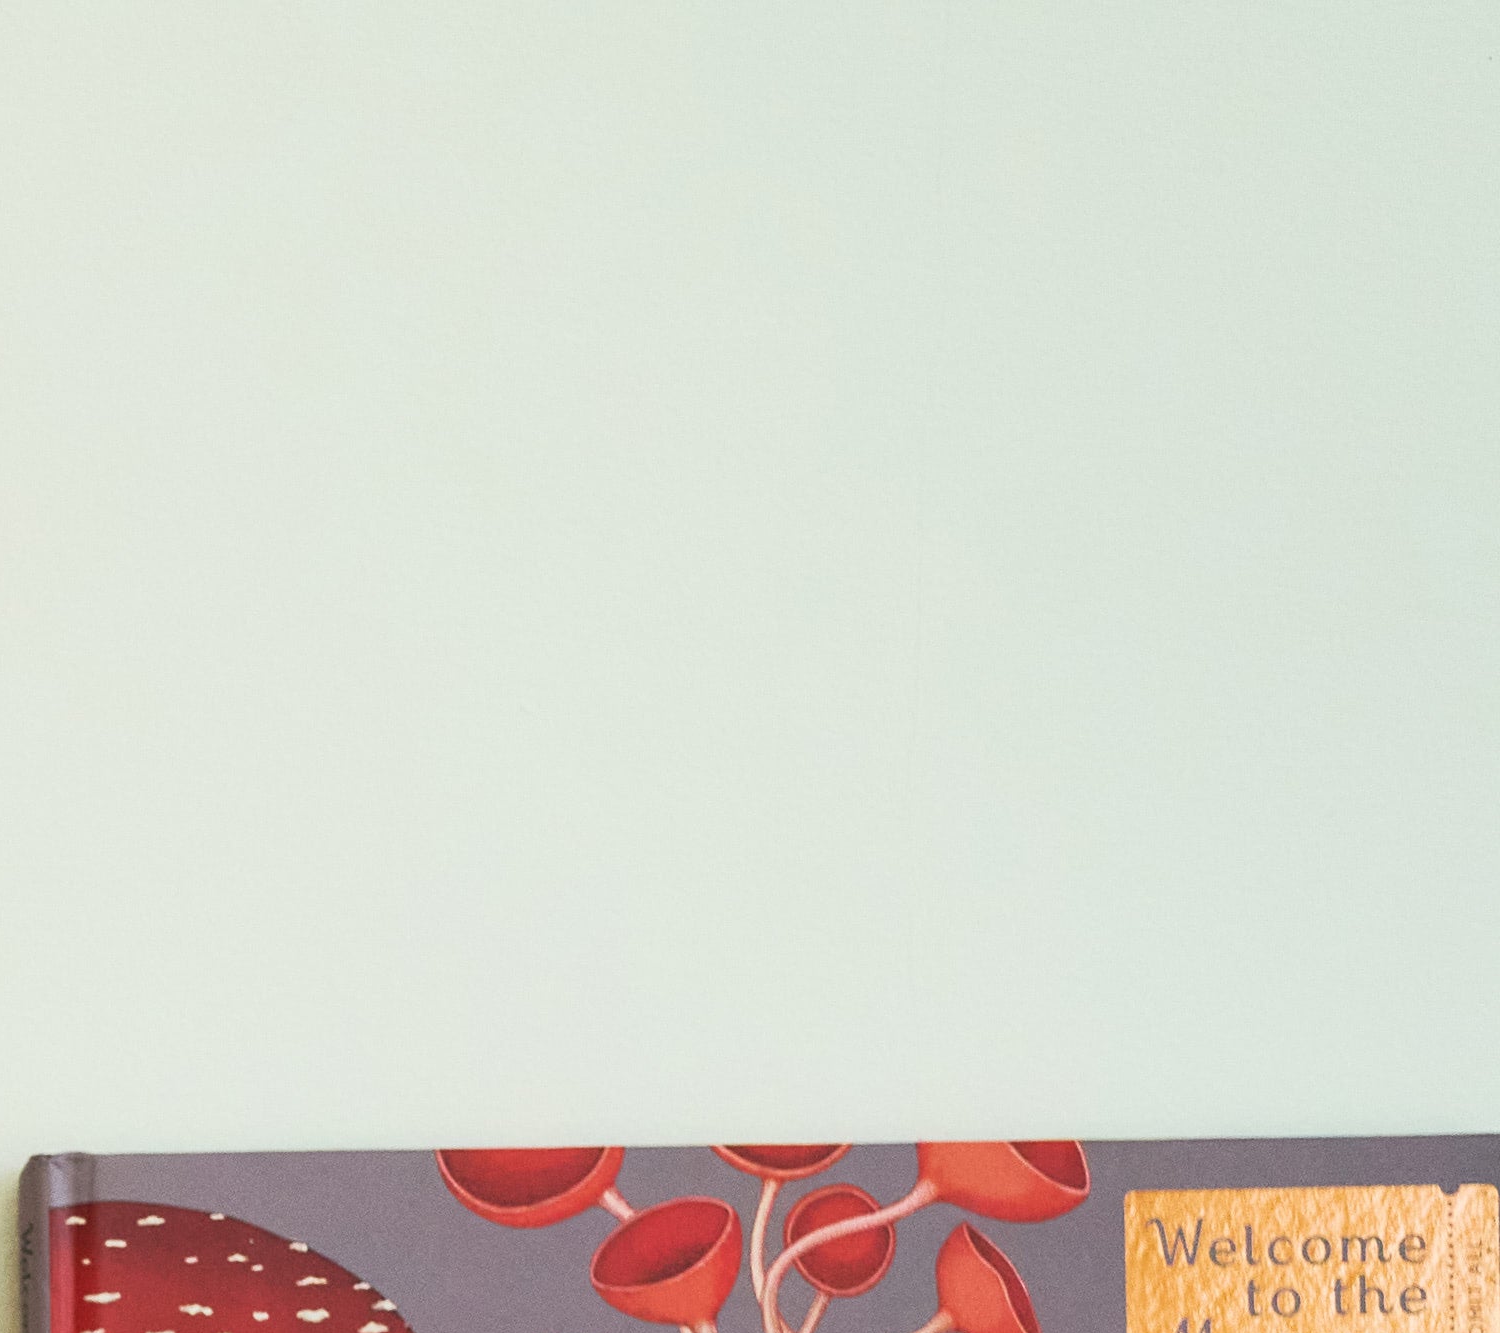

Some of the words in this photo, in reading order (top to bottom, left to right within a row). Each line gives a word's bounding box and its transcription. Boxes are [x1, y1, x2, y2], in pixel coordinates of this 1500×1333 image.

[1148, 1217, 1428, 1267] Welcome
[1248, 1278, 1302, 1317] to
[1334, 1274, 1428, 1315] the
